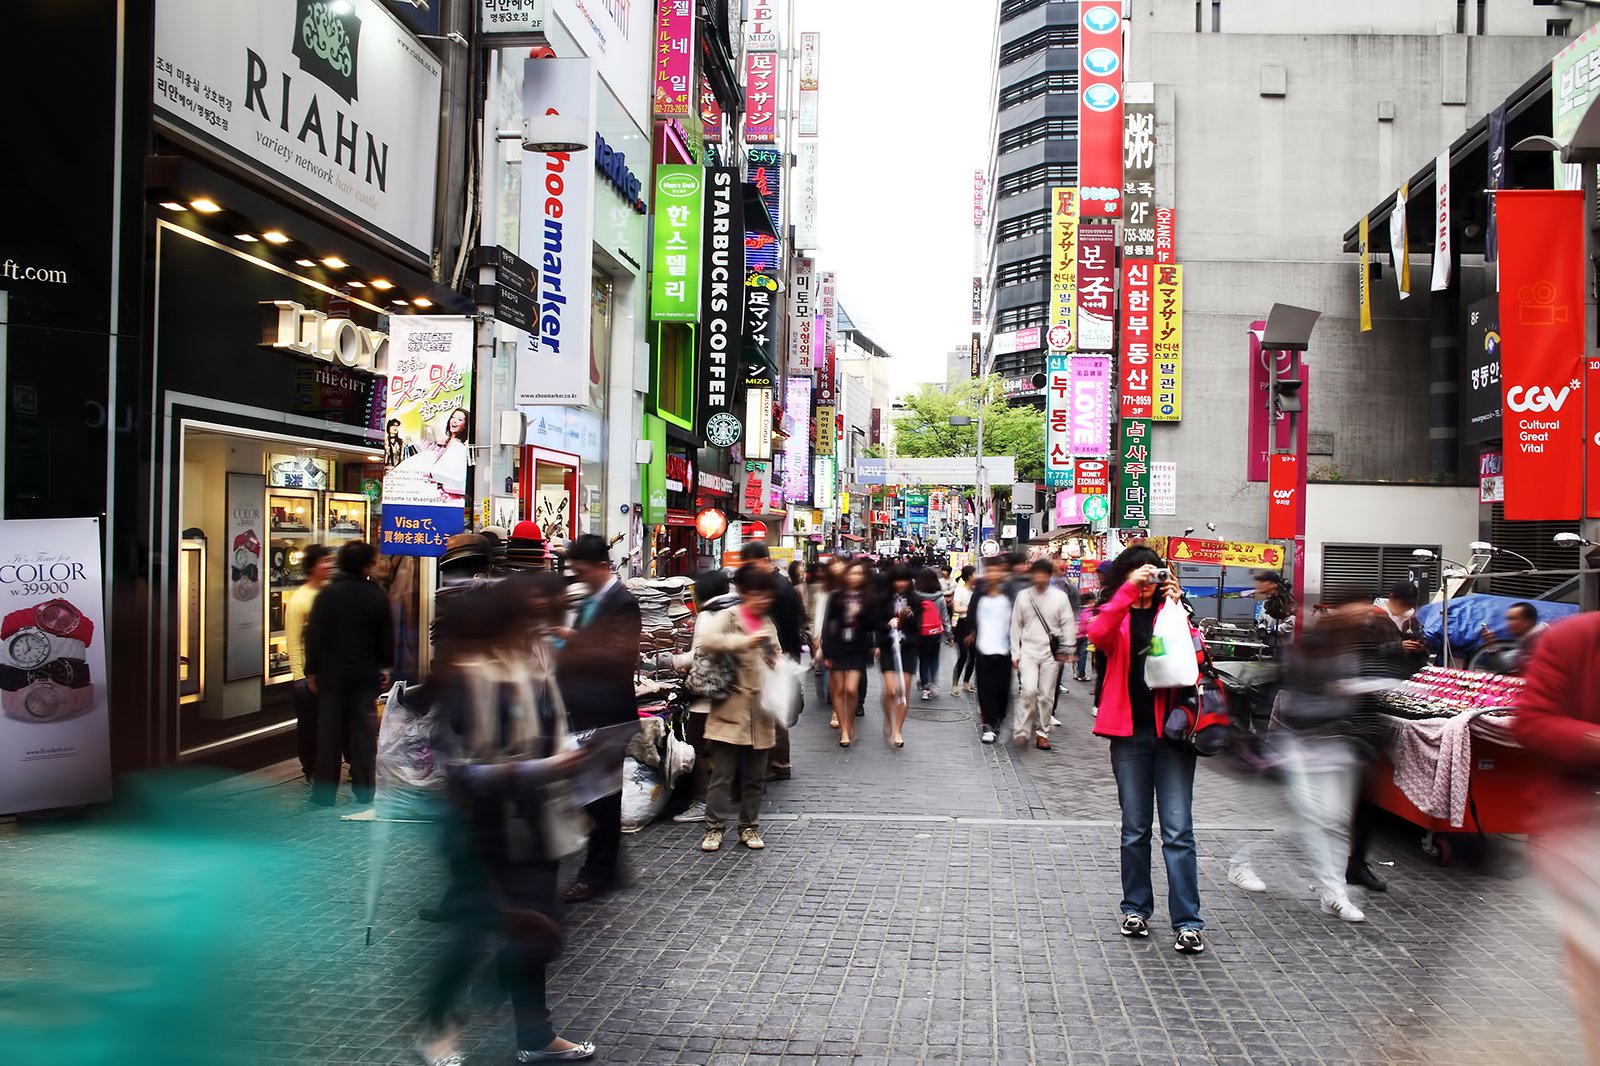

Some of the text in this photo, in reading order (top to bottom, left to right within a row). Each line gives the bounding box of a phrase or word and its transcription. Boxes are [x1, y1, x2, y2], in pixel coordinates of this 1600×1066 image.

[670, 0, 689, 92] 젤네일
[676, 94, 687, 102] 4F
[244, 48, 389, 193] RIAHN
[751, 150, 777, 164] Sky
[256, 130, 379, 211] variety network hair castle
[1124, 182, 1154, 198] 본죽
[1130, 202, 1149, 223] 2F
[1439, 183, 1447, 252] SKONO
[541, 108, 570, 353] hoemarker
[1124, 228, 1154, 242] 755-3562
[664, 204, 690, 303] 한스델리
[1124, 245, 1154, 256] 명동점
[1157, 252, 1169, 262] 1F
[0, 259, 67, 284] ft.com
[1079, 245, 1114, 309] 본죽
[707, 172, 729, 407] STARBUCKS COFFEE
[796, 276, 809, 317] 미토모
[1127, 264, 1150, 391] 신한부동산
[1471, 312, 1480, 325] 8F
[798, 321, 809, 367] 성형외과
[1154, 343, 1180, 352] 컨디션
[314, 370, 366, 394] THE GIFT
[1160, 363, 1176, 405] 발관리
[1471, 360, 1502, 391] 명동안
[520, 391, 577, 399] www.shoemarker.co.kr
[1122, 395, 1152, 405] 771-8959
[1506, 385, 1570, 412] CGV
[1074, 381, 1095, 445] LOVE
[1519, 419, 1560, 430] Cultural
[1519, 432, 1549, 442] Great
[1520, 443, 1544, 453] Vital
[698, 471, 720, 491] STARBUCKS
[720, 478, 733, 493] COFFEE
[1077, 478, 1106, 486] EXCHANGE
[1273, 489, 1291, 498] CGV
[233, 507, 260, 519] COLOR
[0, 562, 87, 584] COLOR
